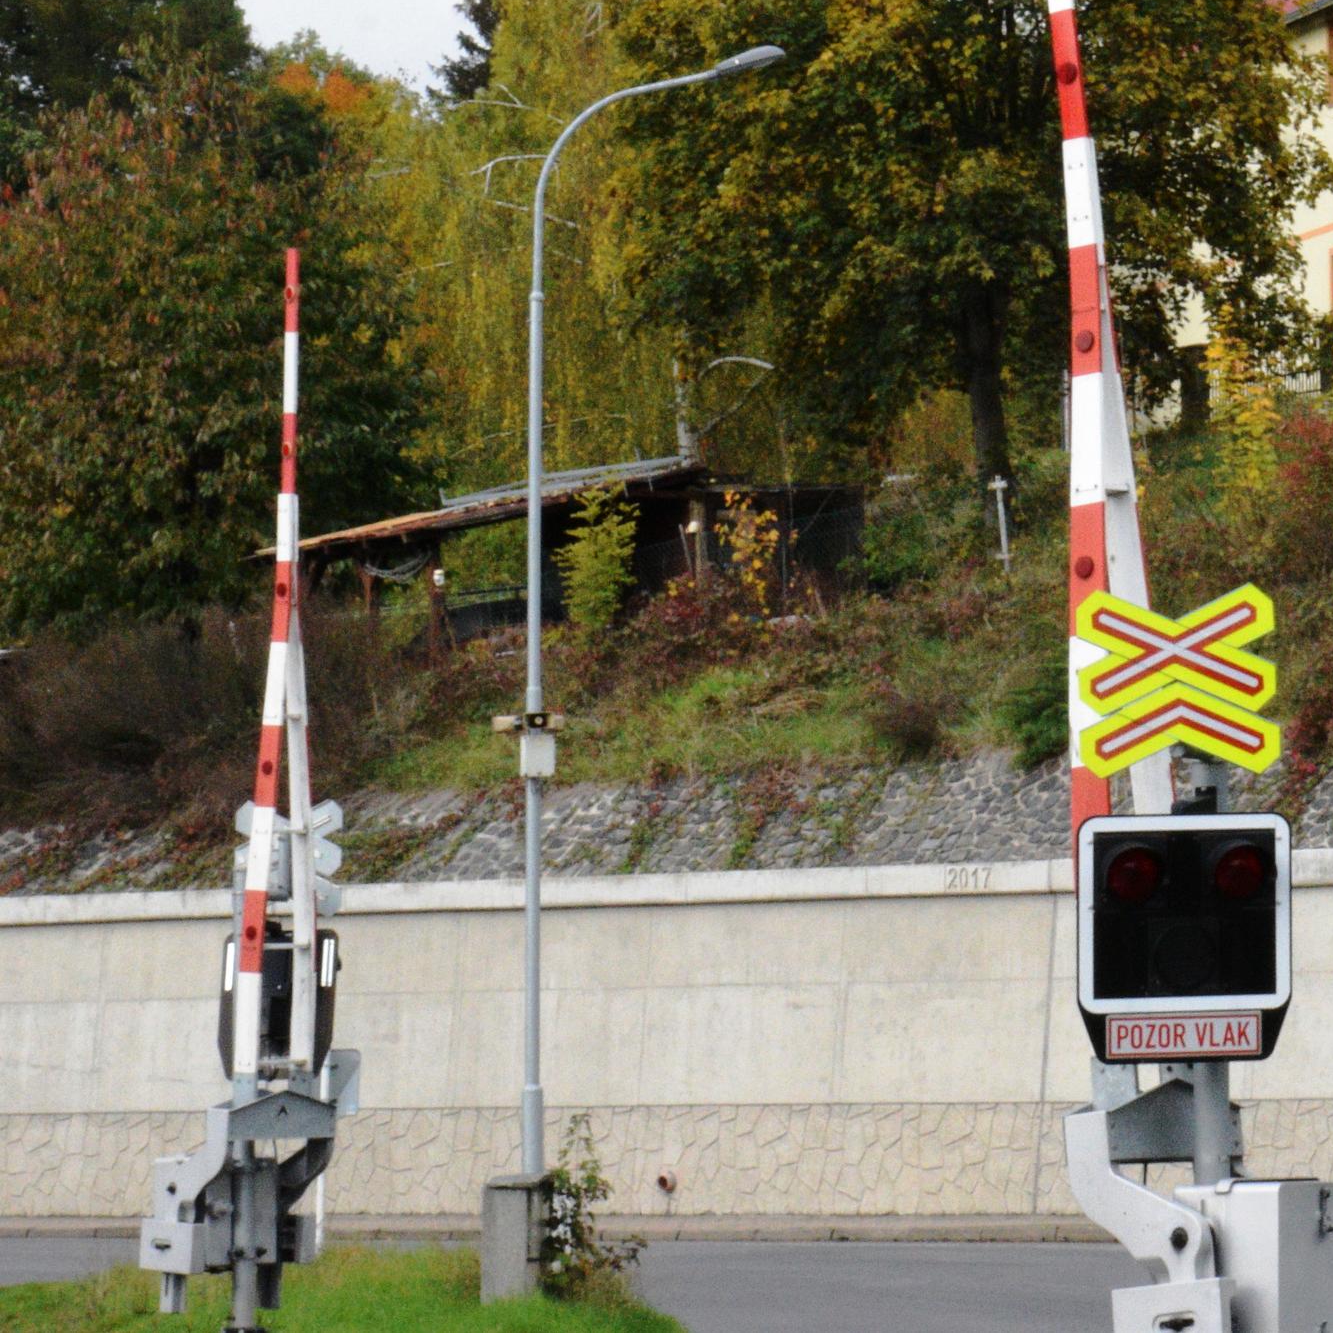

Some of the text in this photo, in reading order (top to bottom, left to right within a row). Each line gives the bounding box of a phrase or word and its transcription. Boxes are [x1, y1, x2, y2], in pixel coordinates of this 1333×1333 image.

[947, 867, 992, 890] 2017
[1116, 1021, 1250, 1049] POZOR VLAK
